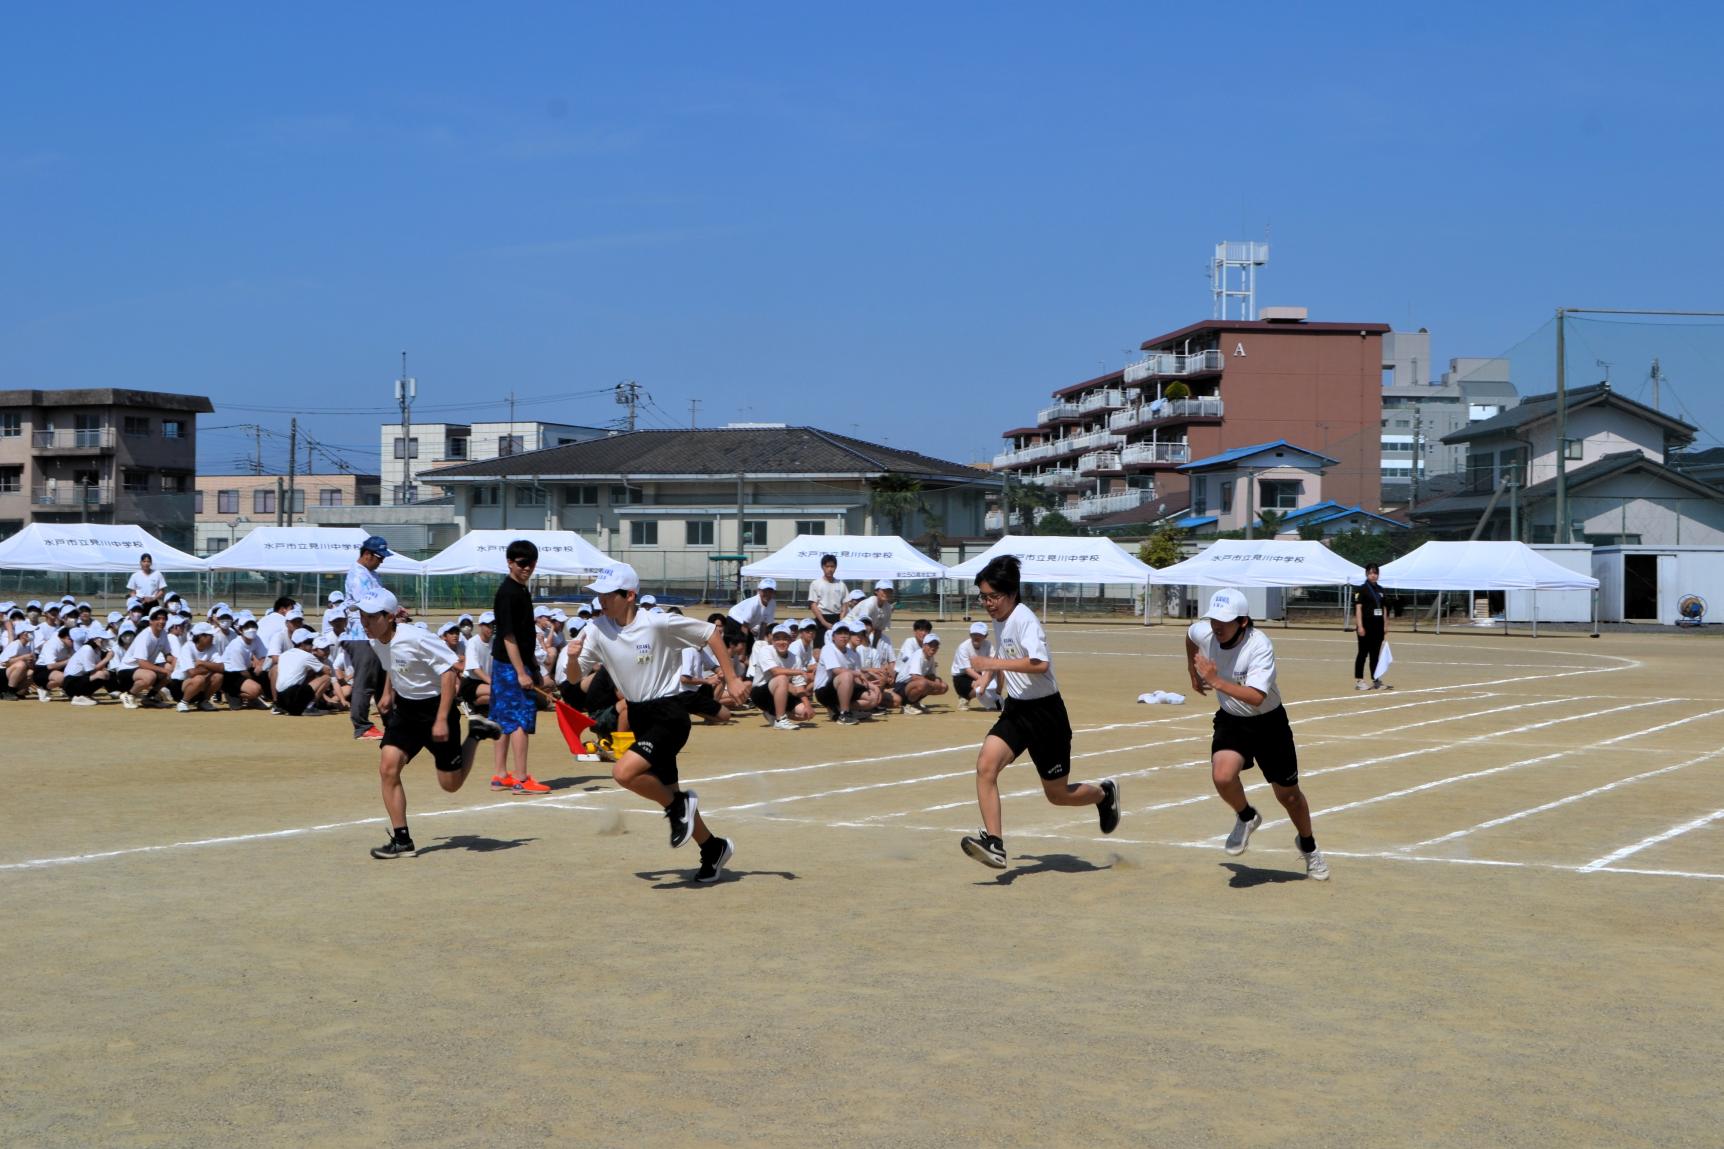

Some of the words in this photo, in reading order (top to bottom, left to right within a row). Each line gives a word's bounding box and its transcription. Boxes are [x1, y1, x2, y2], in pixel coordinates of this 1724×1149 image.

[1233, 342, 1246, 356] A
[44, 538, 143, 548] 水戸市立見川中学校
[1015, 553, 1100, 562] 戸市立見川中学校
[1211, 554, 1305, 563] 水戸市立見川中学校
